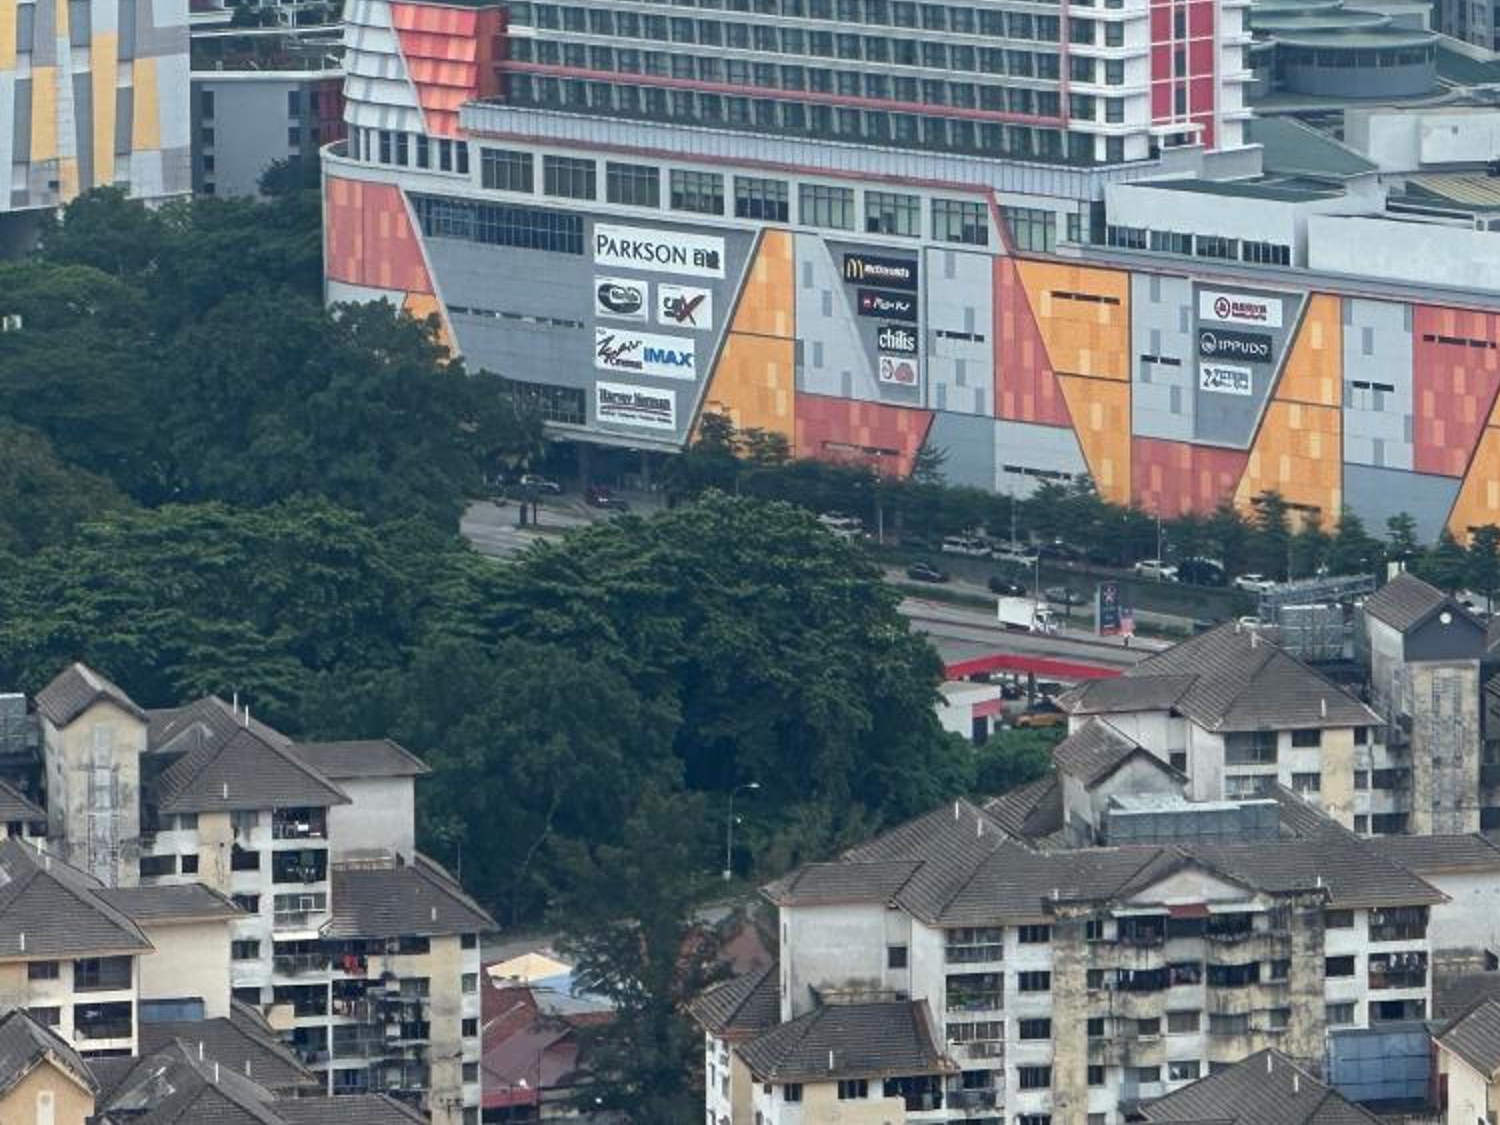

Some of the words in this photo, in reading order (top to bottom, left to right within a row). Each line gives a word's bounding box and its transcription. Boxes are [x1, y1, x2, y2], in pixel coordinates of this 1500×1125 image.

[597, 234, 687, 265] PARKSON
[643, 346, 692, 367] IMAX
[1219, 339, 1268, 356] IPPUDO
